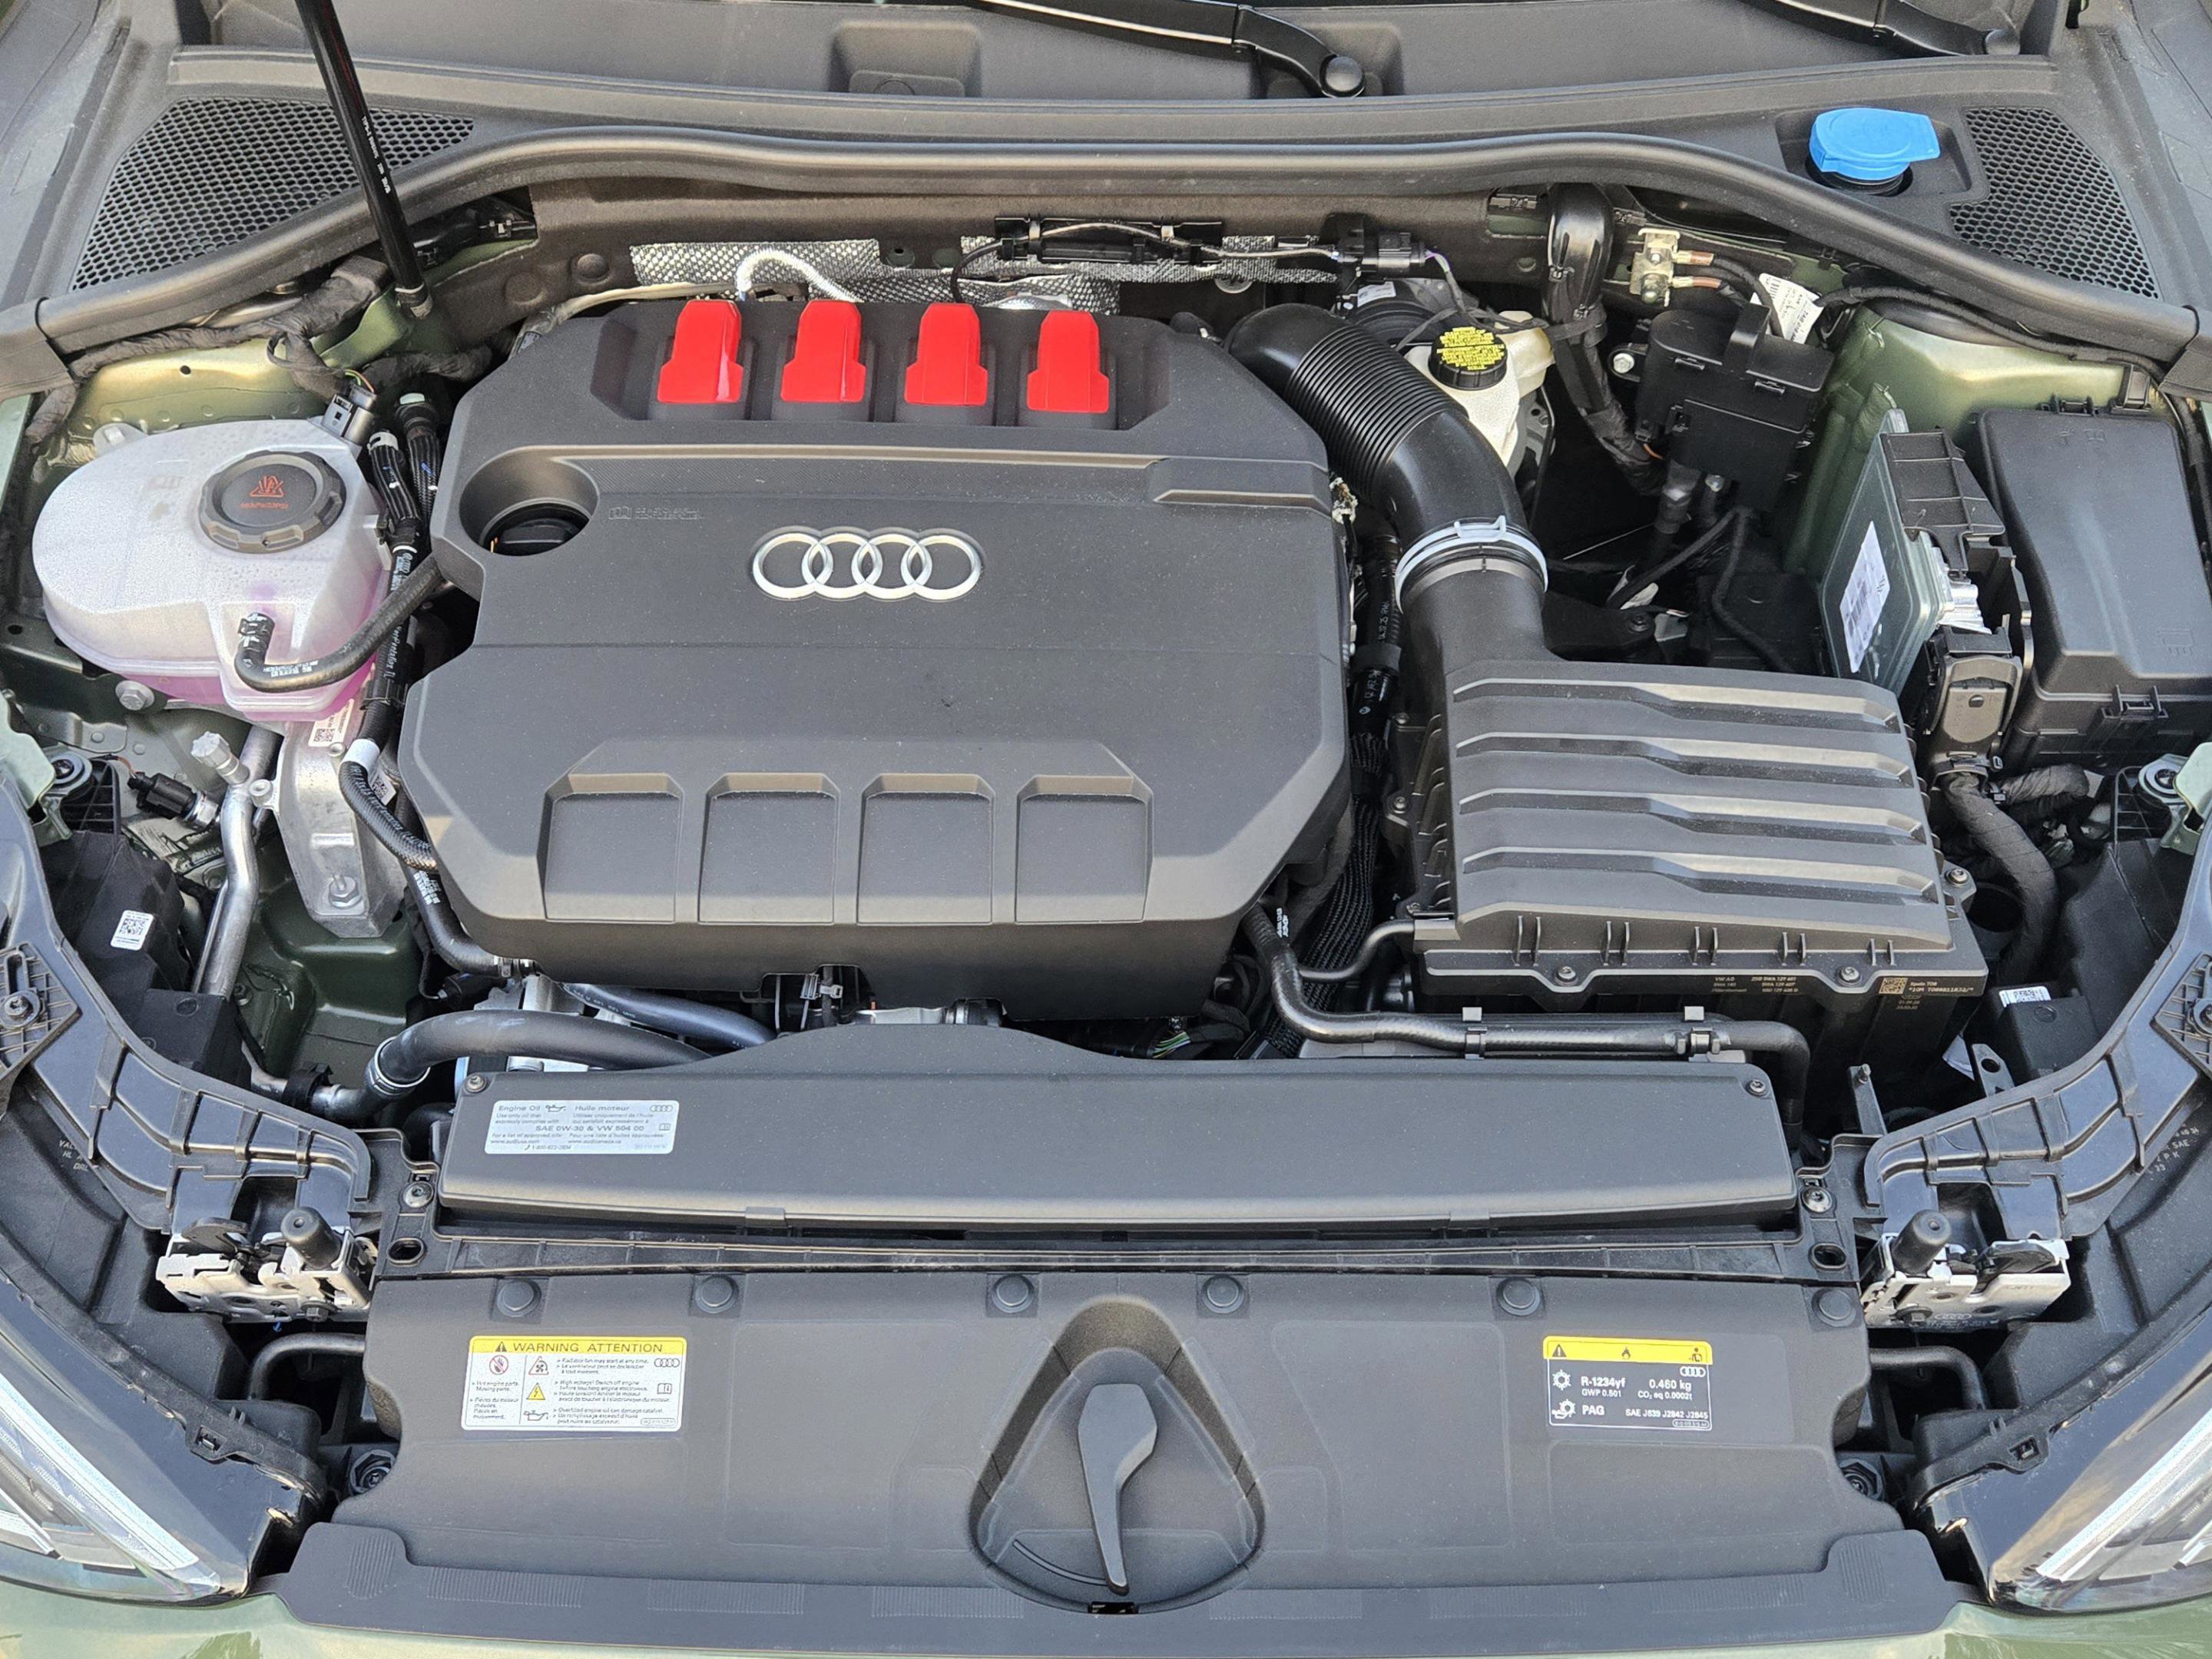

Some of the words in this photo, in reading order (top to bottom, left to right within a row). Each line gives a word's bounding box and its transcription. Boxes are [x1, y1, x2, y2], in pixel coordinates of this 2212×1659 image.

[2172, 1139, 2190, 1149] SAE
[513, 1343, 579, 1352] WARNING
[587, 1343, 664, 1352] ATTENTION
[1581, 1376, 1626, 1389] R-1234yf
[1648, 1379, 1677, 1389] 0.460
[1679, 1379, 1692, 1392] kg
[1581, 1389, 1601, 1397] GWP
[1653, 1392, 1664, 1401] eq
[1582, 1406, 1605, 1416] PAG
[1625, 1409, 1641, 1417] SAE
[1662, 1410, 1684, 1419] J2842
[1685, 1411, 1709, 1419] J2845
